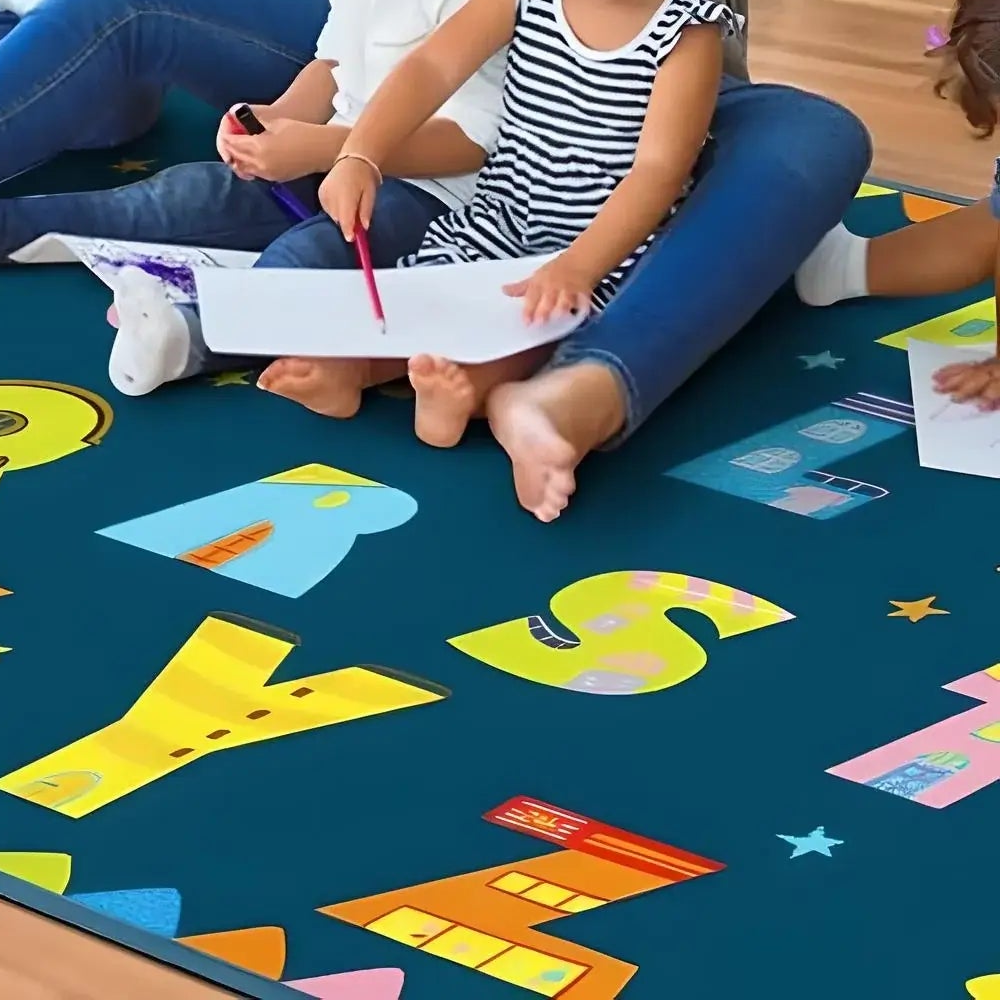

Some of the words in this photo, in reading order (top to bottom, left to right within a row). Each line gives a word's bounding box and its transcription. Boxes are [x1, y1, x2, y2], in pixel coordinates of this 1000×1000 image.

[94, 462, 418, 598] R
[446, 570, 796, 695] S
[314, 795, 728, 1000] Z
